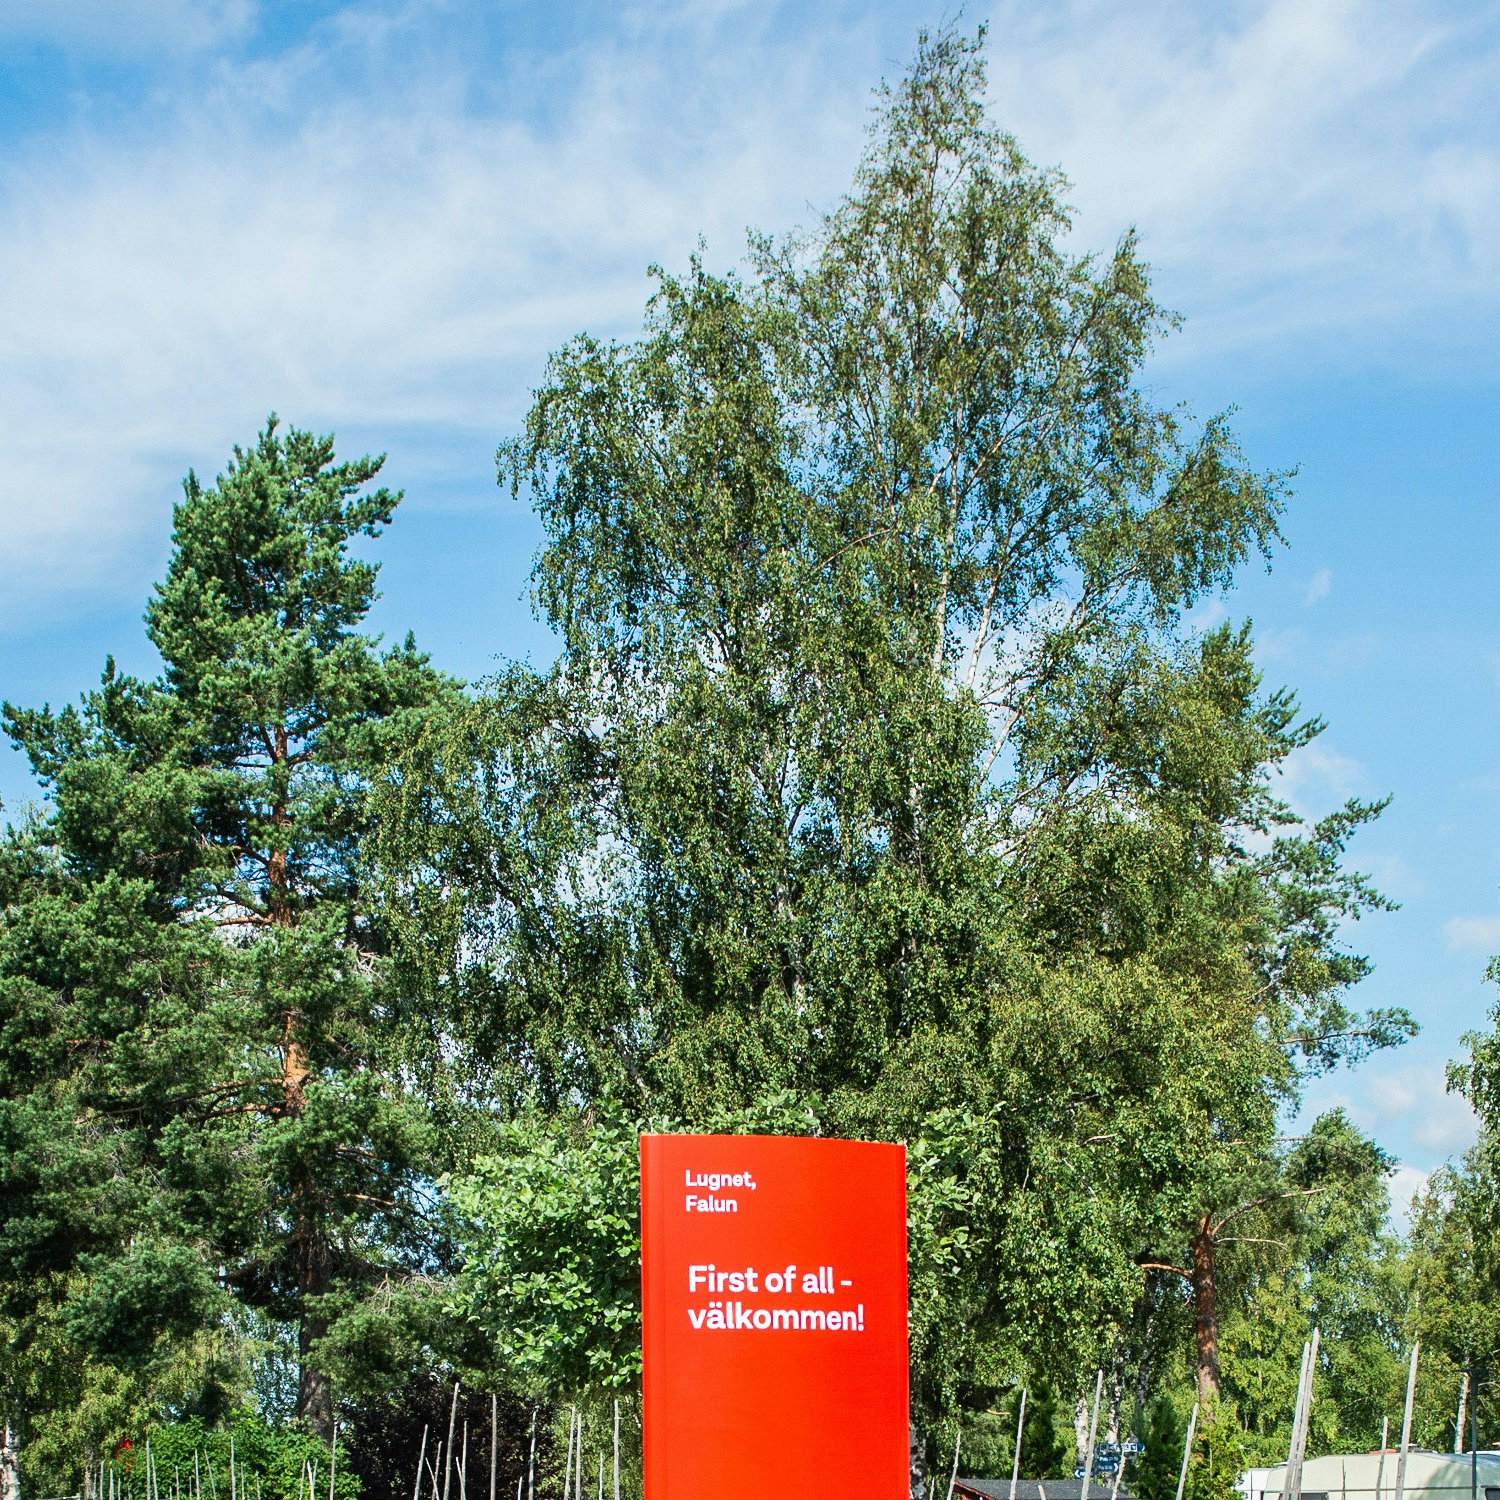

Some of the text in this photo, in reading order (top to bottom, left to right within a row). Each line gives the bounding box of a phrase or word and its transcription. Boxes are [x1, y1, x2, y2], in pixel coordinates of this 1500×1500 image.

[685, 1169, 757, 1191] Lugnet,
[685, 1194, 738, 1213] Falun
[688, 1264, 759, 1293] First
[765, 1264, 797, 1293] of
[801, 1266, 835, 1294] all
[687, 1301, 865, 1332] välkommen!
